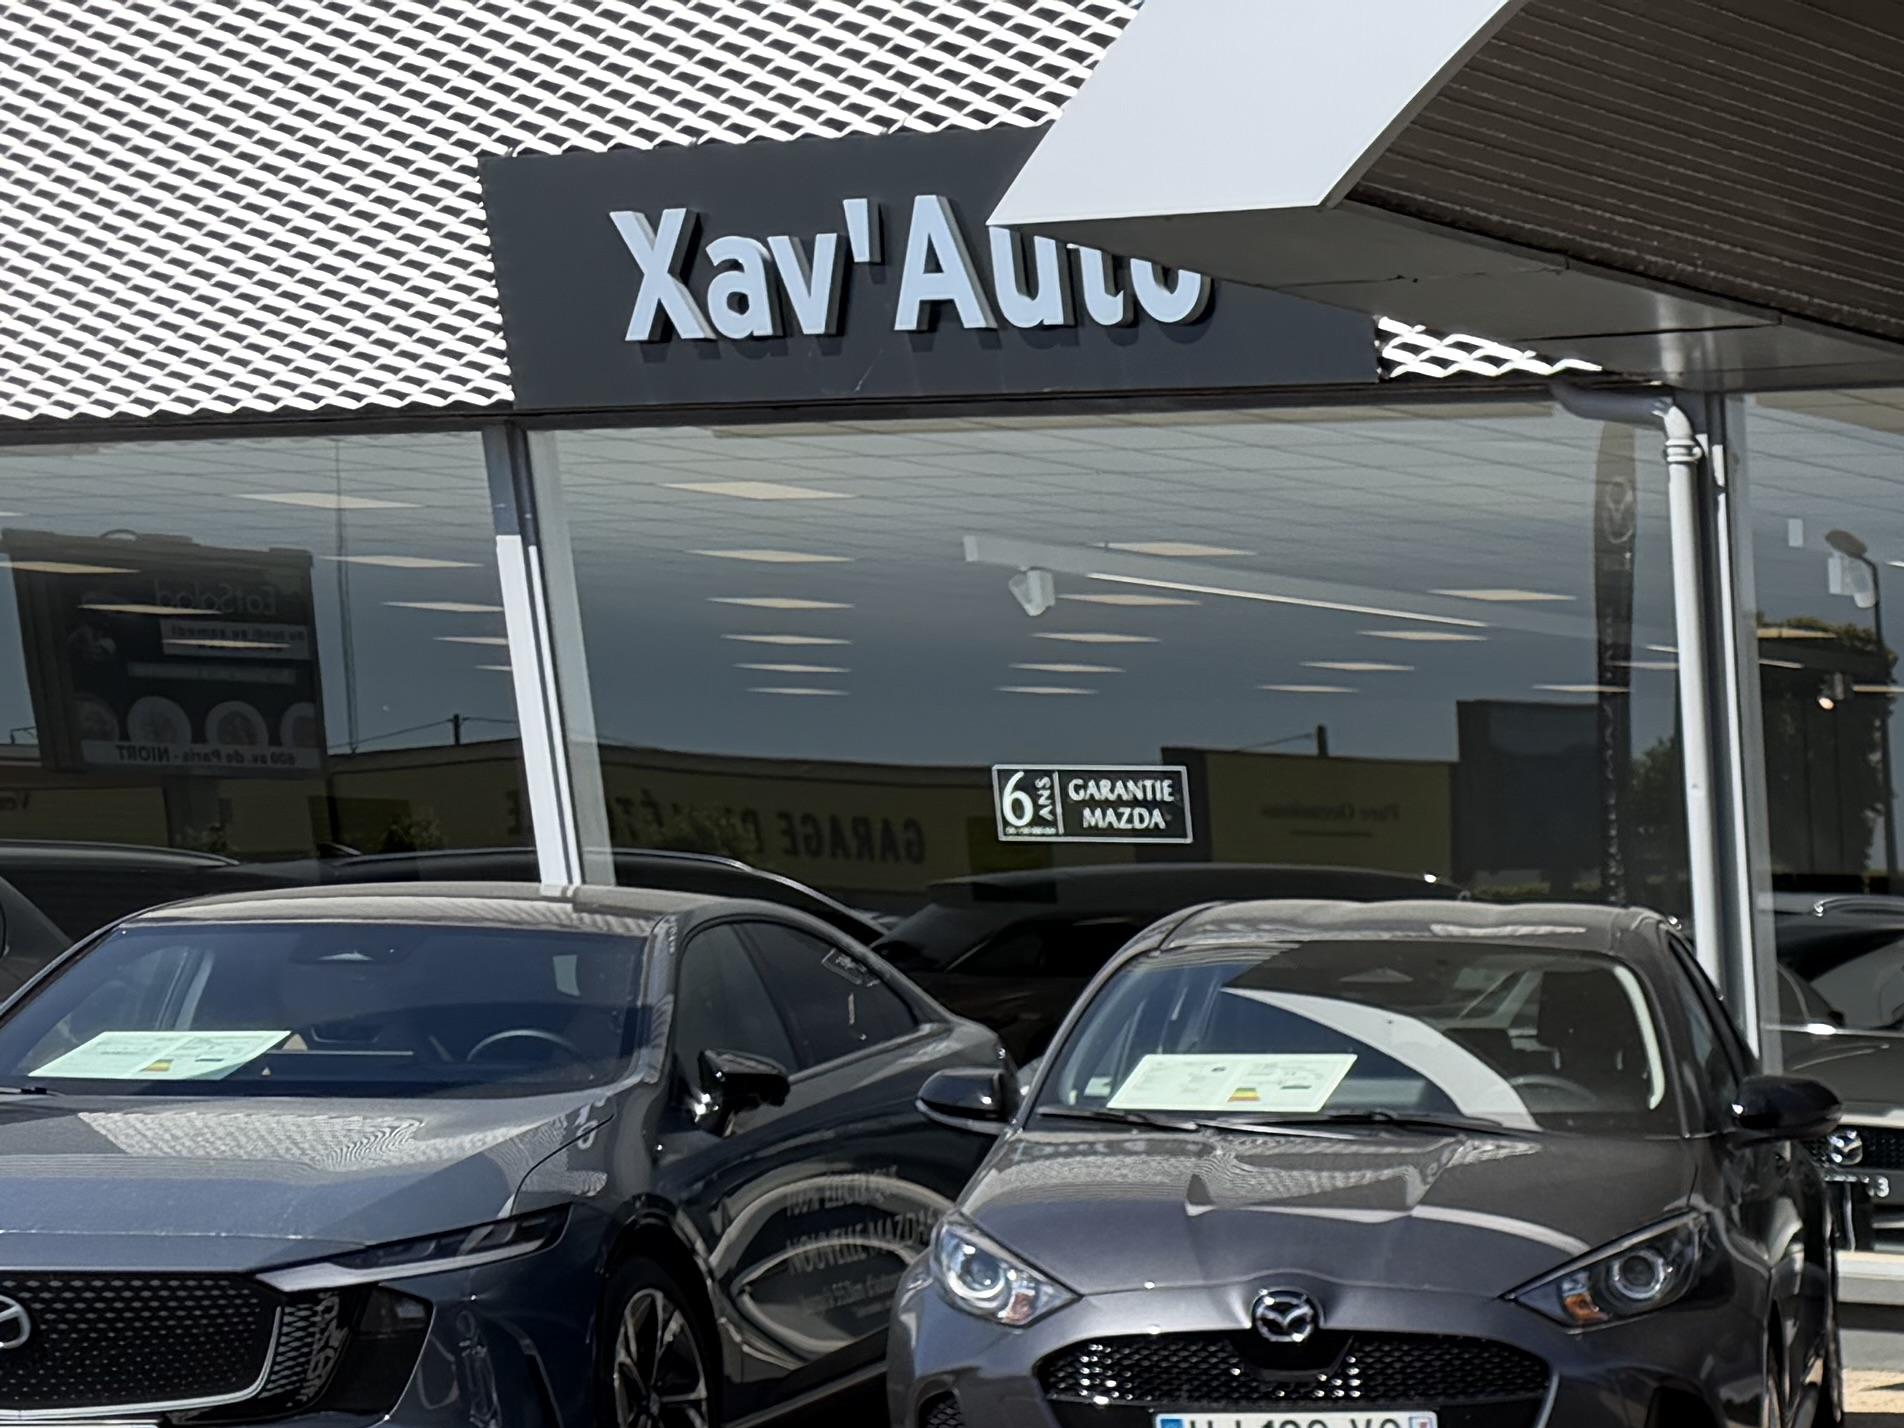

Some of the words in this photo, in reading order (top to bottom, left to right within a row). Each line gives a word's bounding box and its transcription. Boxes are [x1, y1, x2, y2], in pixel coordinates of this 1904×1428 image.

[610, 194, 1207, 342] Xav'Auto
[1002, 771, 1034, 827] 6
[1034, 776, 1054, 821] ANS
[1068, 778, 1175, 802] GARANTIE
[1082, 807, 1167, 830] MAZDA
